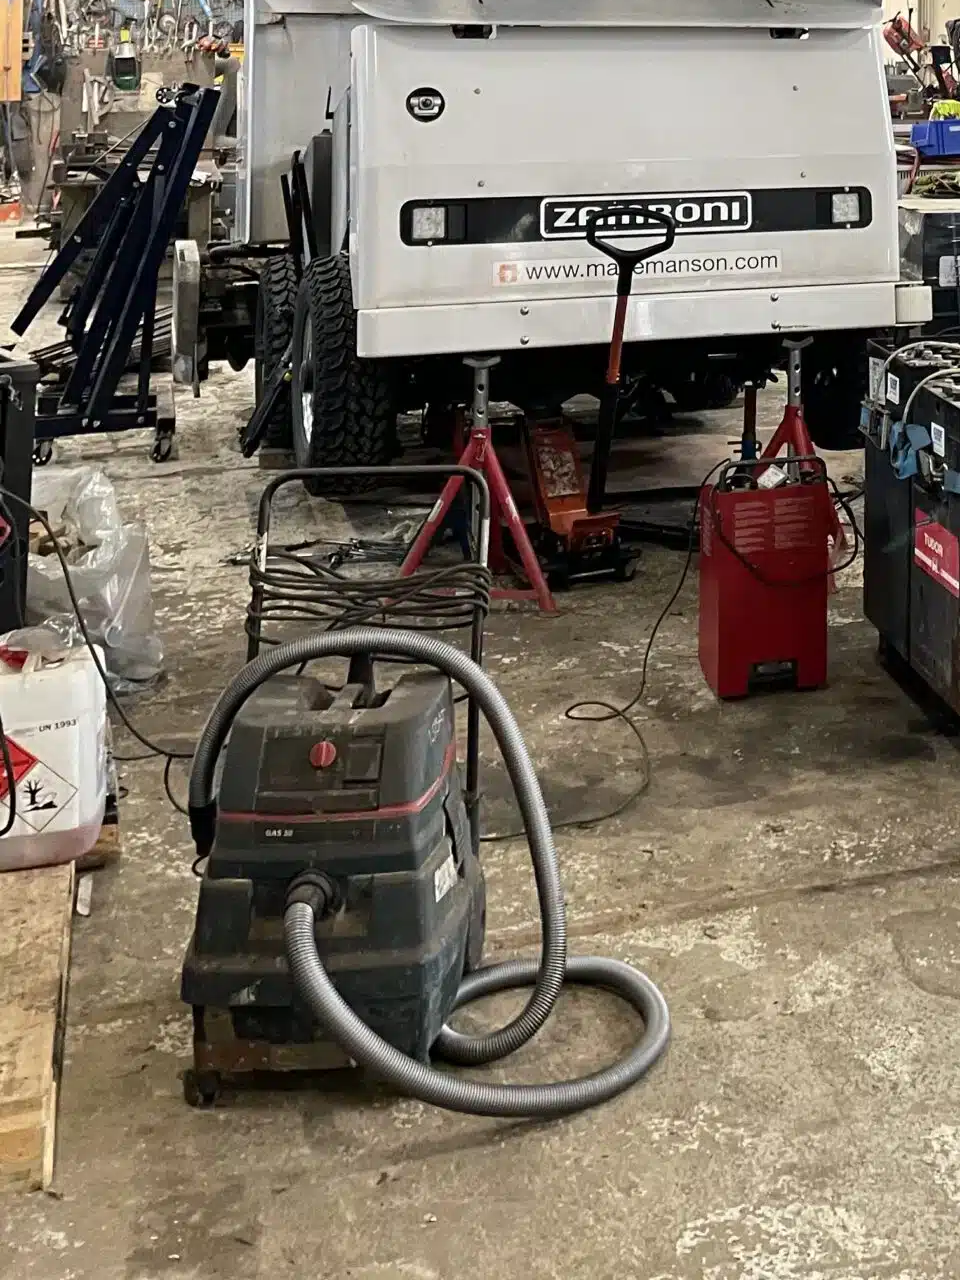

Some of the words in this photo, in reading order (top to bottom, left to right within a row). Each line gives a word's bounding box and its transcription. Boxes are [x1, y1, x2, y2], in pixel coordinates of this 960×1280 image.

[525, 255, 779, 280] www.maemanson.com
[39, 724, 51, 732] UN
[55, 719, 77, 730] 1993
